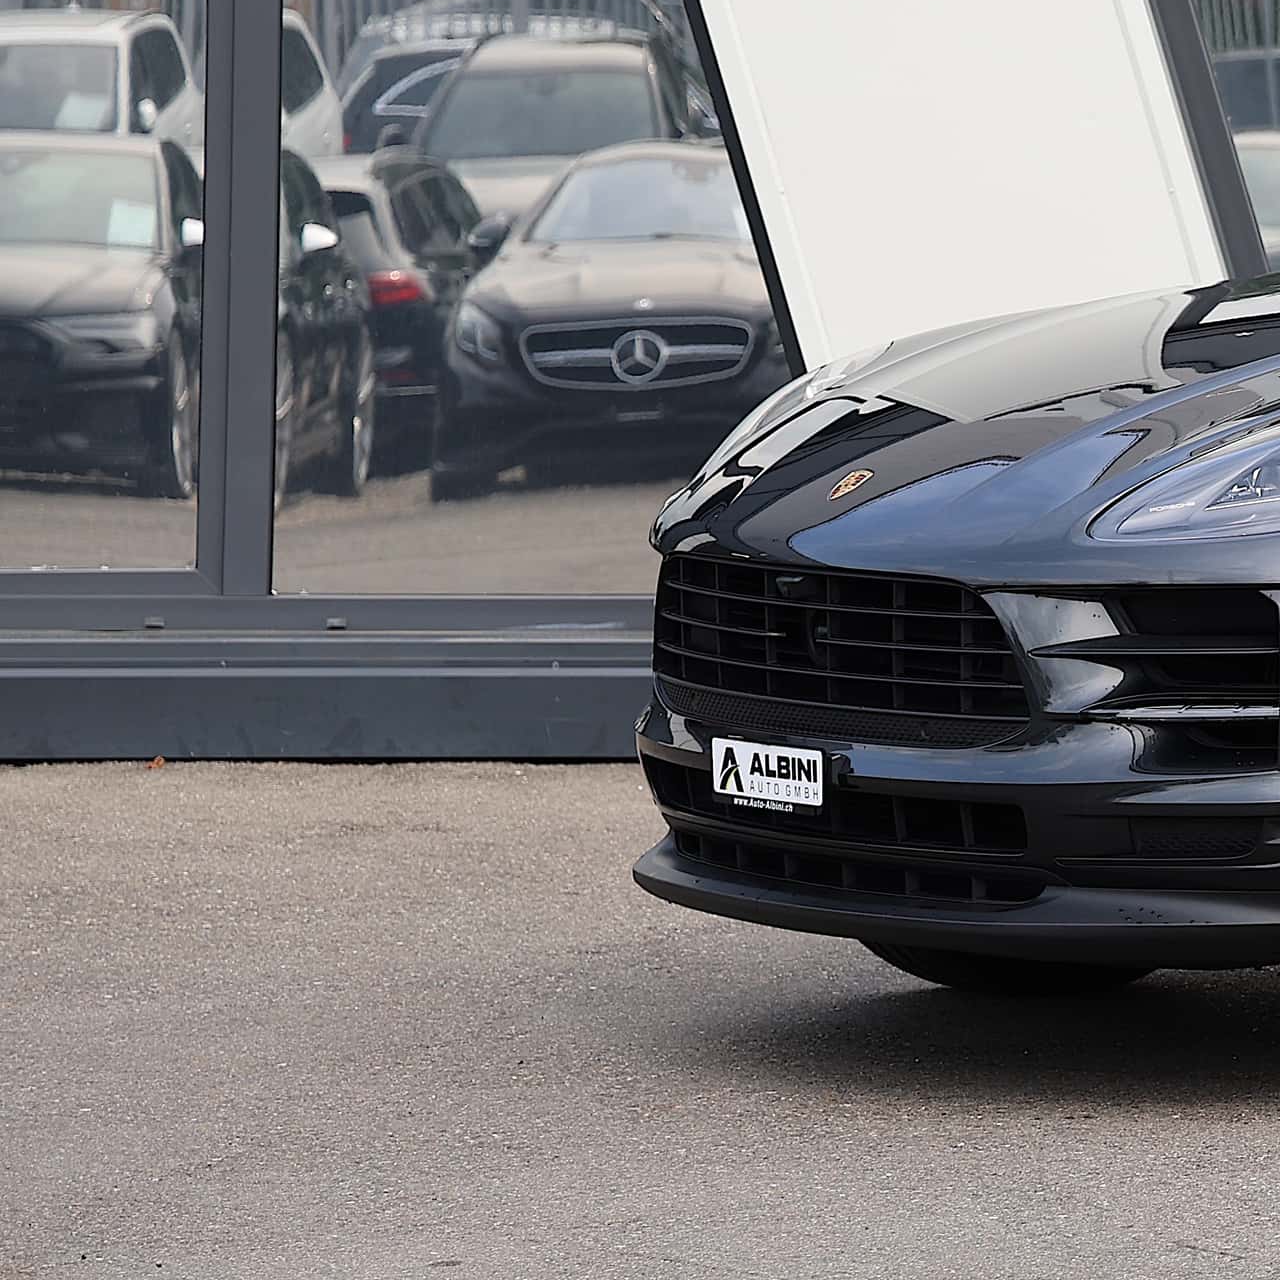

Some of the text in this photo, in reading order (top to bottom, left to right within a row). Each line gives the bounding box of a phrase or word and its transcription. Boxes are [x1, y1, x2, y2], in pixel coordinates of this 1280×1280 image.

[749, 752, 818, 784] ALBINI
[749, 779, 819, 801] AUTO GMBH
